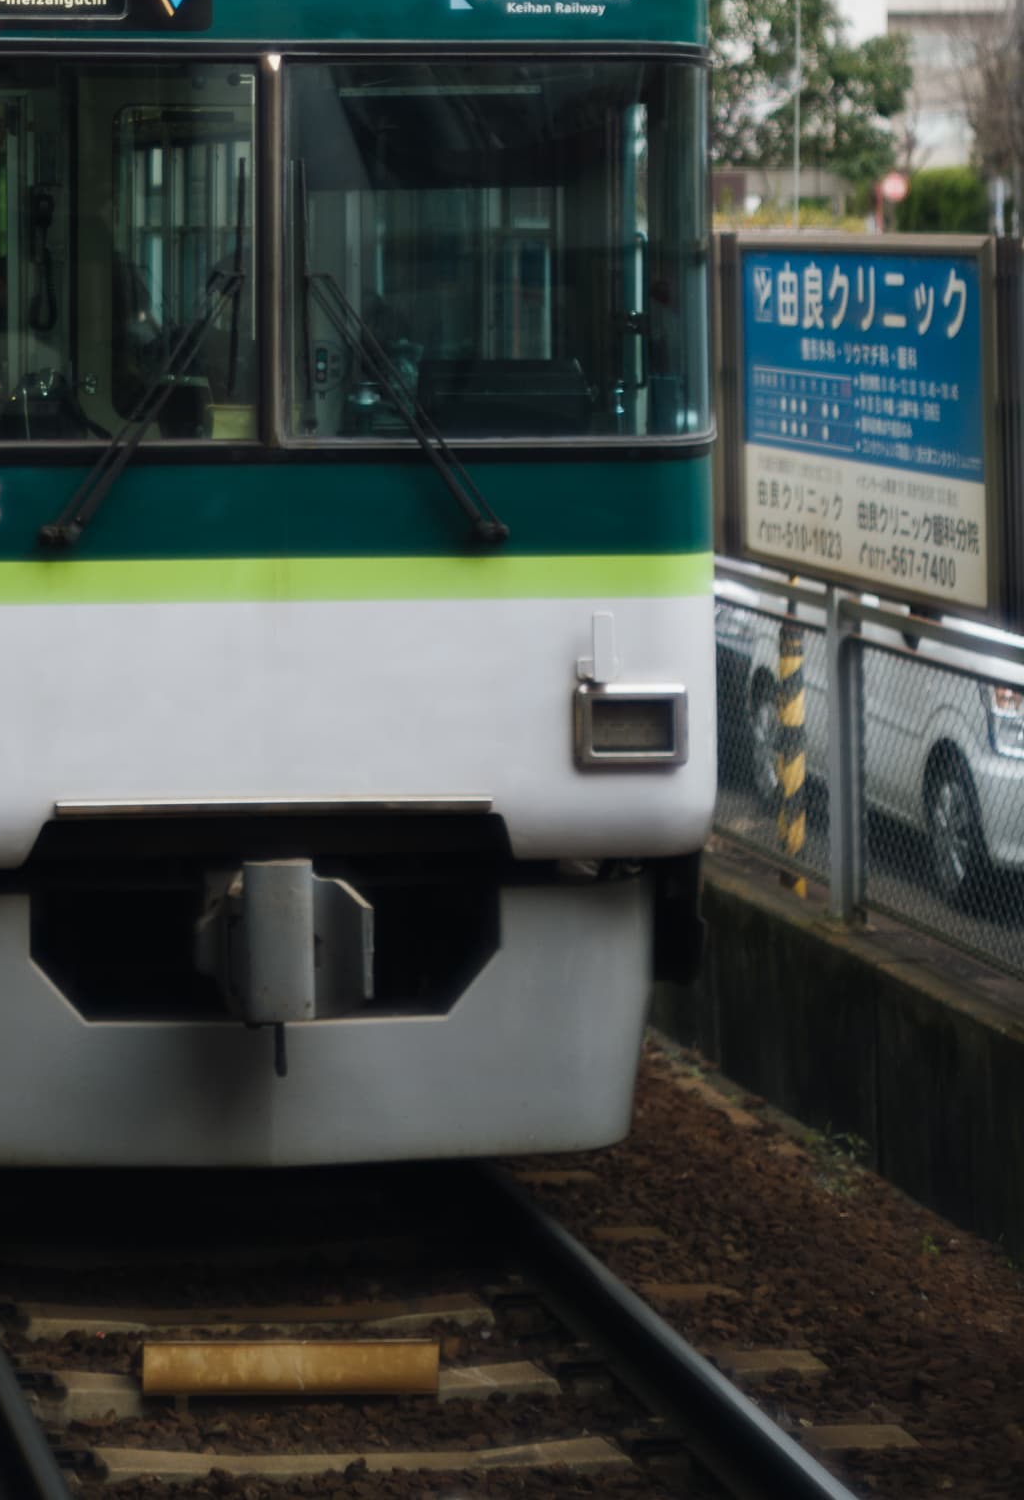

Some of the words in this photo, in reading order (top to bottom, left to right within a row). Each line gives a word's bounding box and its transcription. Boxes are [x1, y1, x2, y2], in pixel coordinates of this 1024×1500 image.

[507, 2, 552, 14] Keihan
[555, 2, 606, 17] Railway
[778, 261, 967, 339] 由良クリニック
[757, 478, 844, 521] 由良クリニック
[867, 546, 957, 589] 077-567-7400
